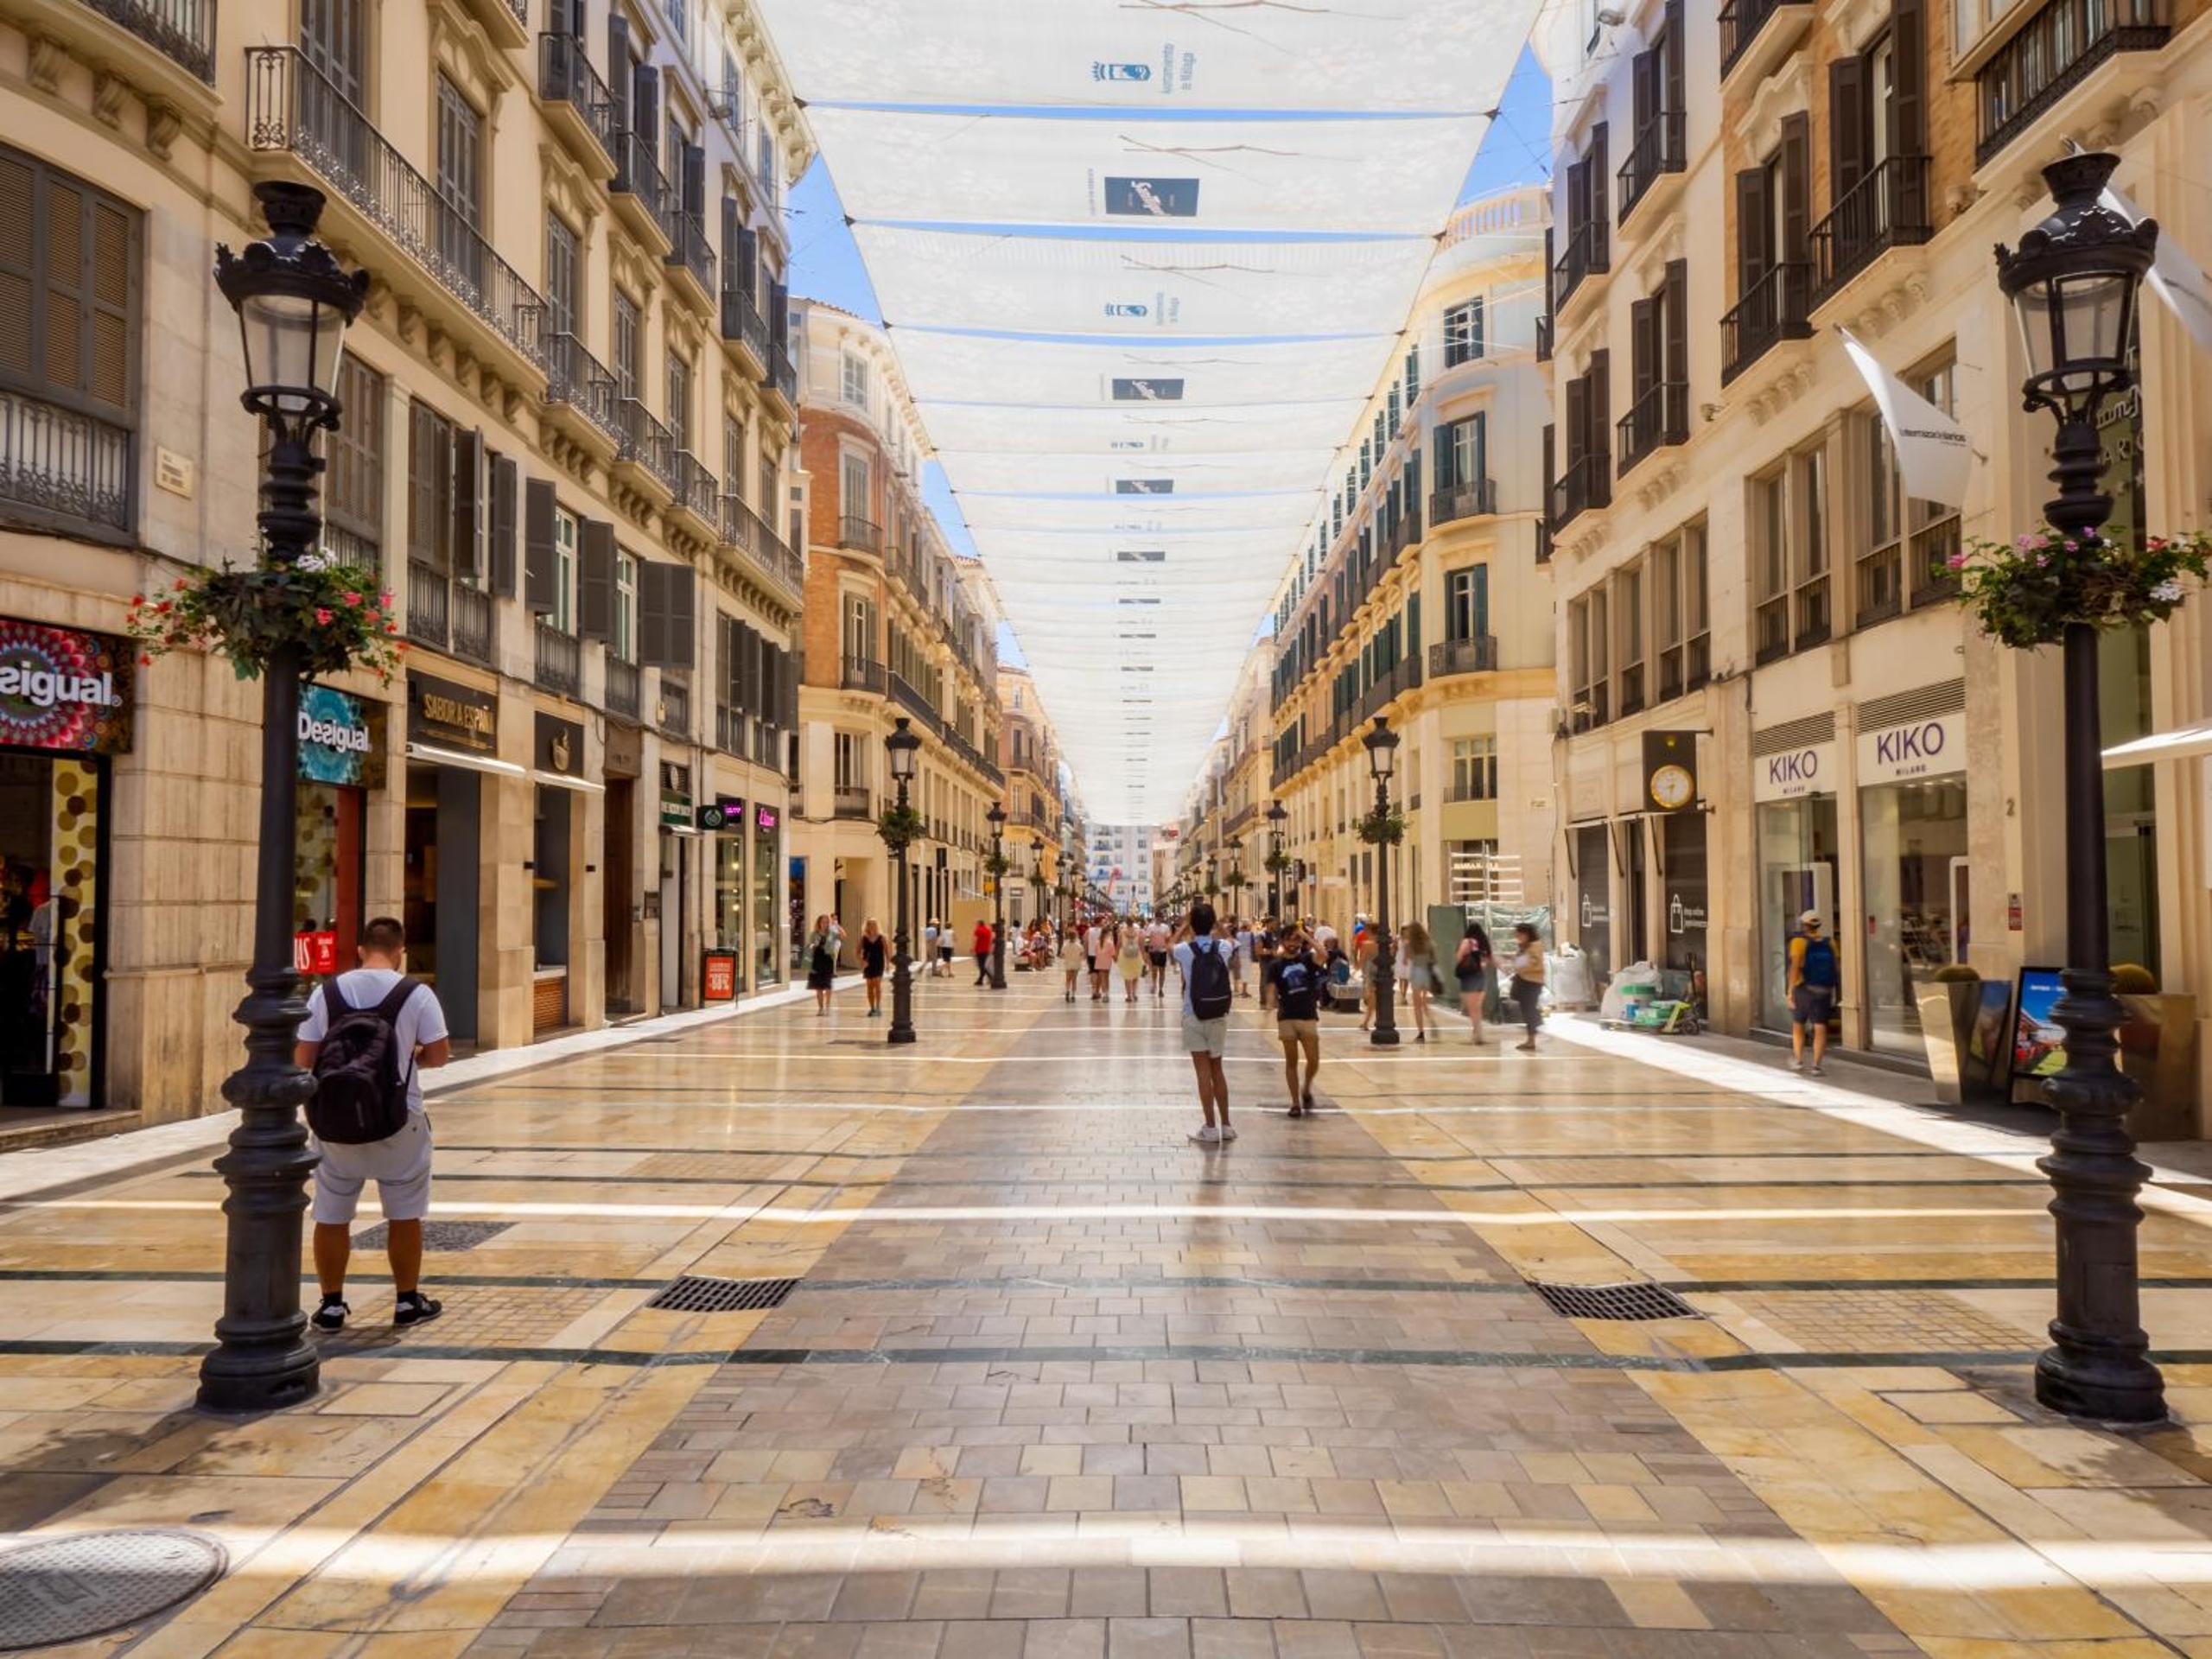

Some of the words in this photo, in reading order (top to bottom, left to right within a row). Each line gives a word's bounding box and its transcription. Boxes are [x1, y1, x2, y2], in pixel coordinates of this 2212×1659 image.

[423, 693, 457, 724] SABOR
[457, 703, 463, 727] A
[297, 710, 369, 753] Desigual
[1877, 722, 1944, 765] KIKO
[1769, 750, 1818, 785] KIKO
[1895, 764, 1927, 777] MILANO
